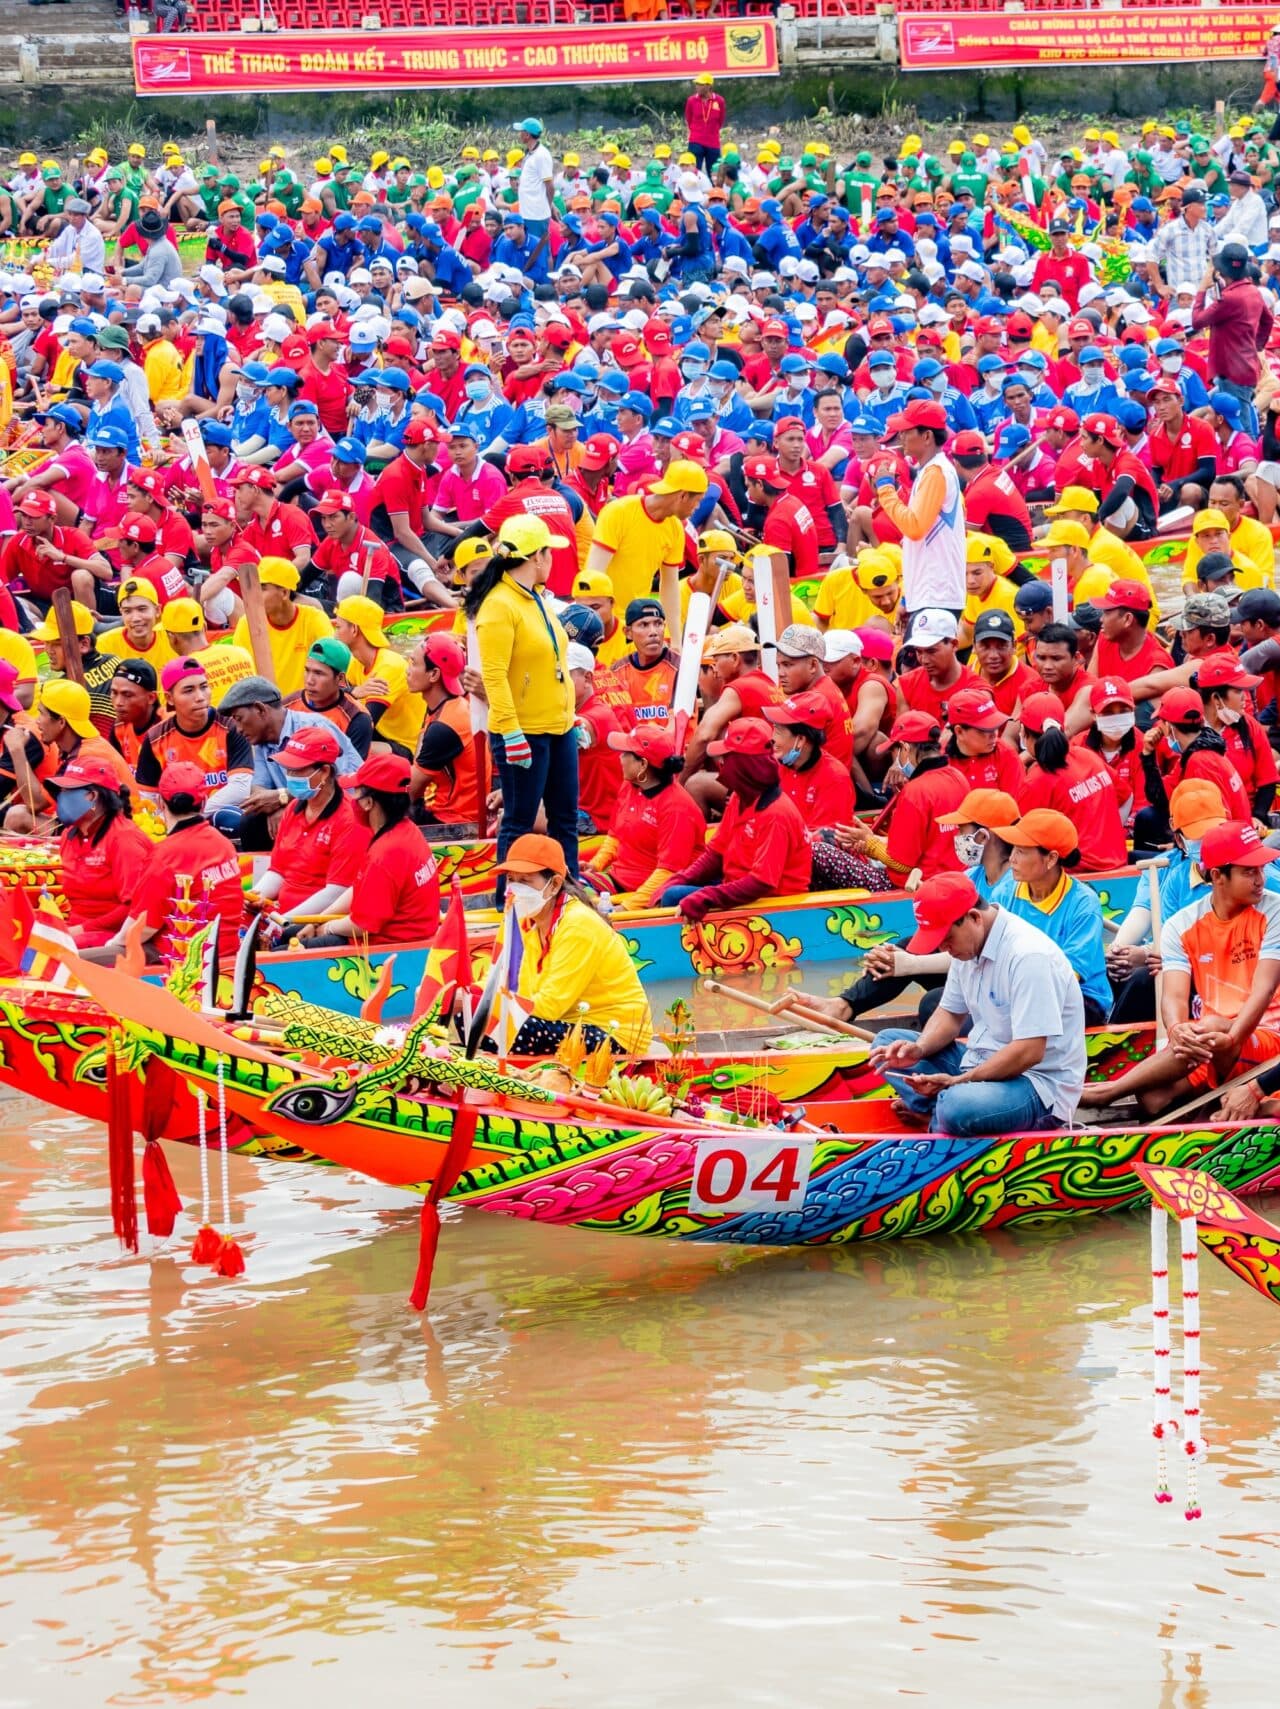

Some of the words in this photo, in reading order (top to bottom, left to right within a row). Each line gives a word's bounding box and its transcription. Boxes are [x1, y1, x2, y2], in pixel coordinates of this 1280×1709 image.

[1009, 18, 1039, 31] CHÀO
[202, 48, 236, 74] THỂ
[241, 53, 291, 73] THAO:
[300, 48, 349, 72] ĐOÀN
[354, 46, 386, 71] KẾT
[402, 49, 459, 71] TRUNG
[464, 44, 508, 72] THỰC
[524, 46, 558, 67] CAO
[562, 42, 630, 68] THƯỢNG
[644, 36, 683, 62] TIẾN
[686, 37, 708, 64] BỘ
[697, 1147, 800, 1205] 04
